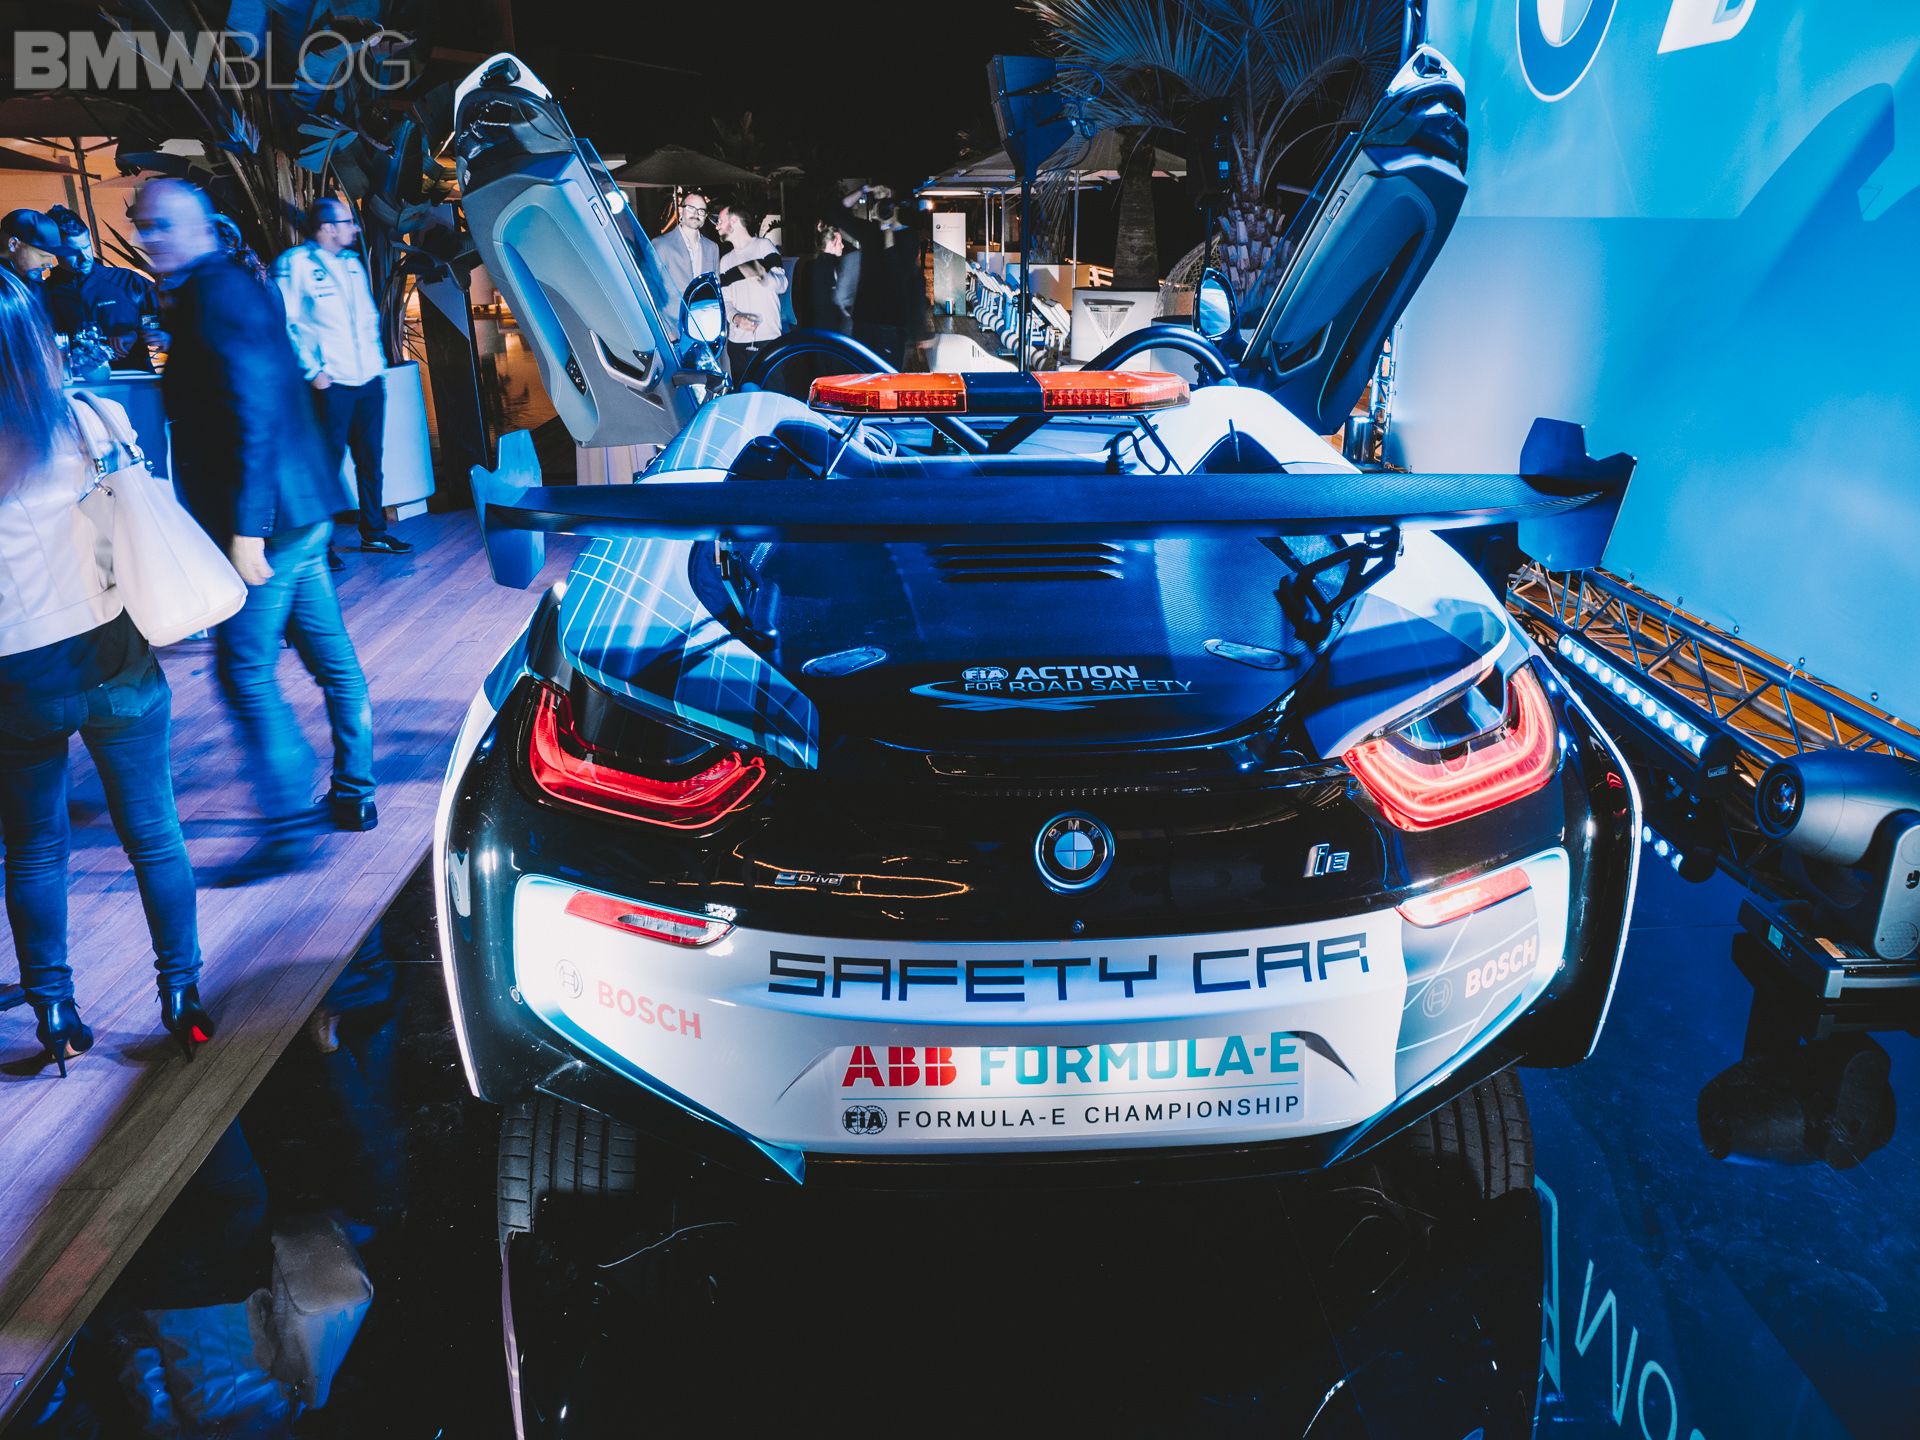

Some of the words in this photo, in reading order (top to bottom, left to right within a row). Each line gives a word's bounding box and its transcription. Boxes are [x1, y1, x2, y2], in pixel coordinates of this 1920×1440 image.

[964, 682, 1002, 691] FOR
[1008, 681, 1083, 693] ROAD
[1092, 680, 1192, 691] SAFETY
[1015, 665, 1139, 680] ACTION
[768, 950, 1158, 1002] SAFETY
[1193, 932, 1369, 994] CAR
[1465, 935, 1538, 999] BOSCH
[598, 979, 702, 1040] BOSCH
[841, 1045, 958, 1087] ABB
[979, 1031, 1299, 1087] FORMULA-E
[898, 1108, 1066, 1128] FORMULA-E
[1085, 1096, 1299, 1124] CHAMPIONSHIP
